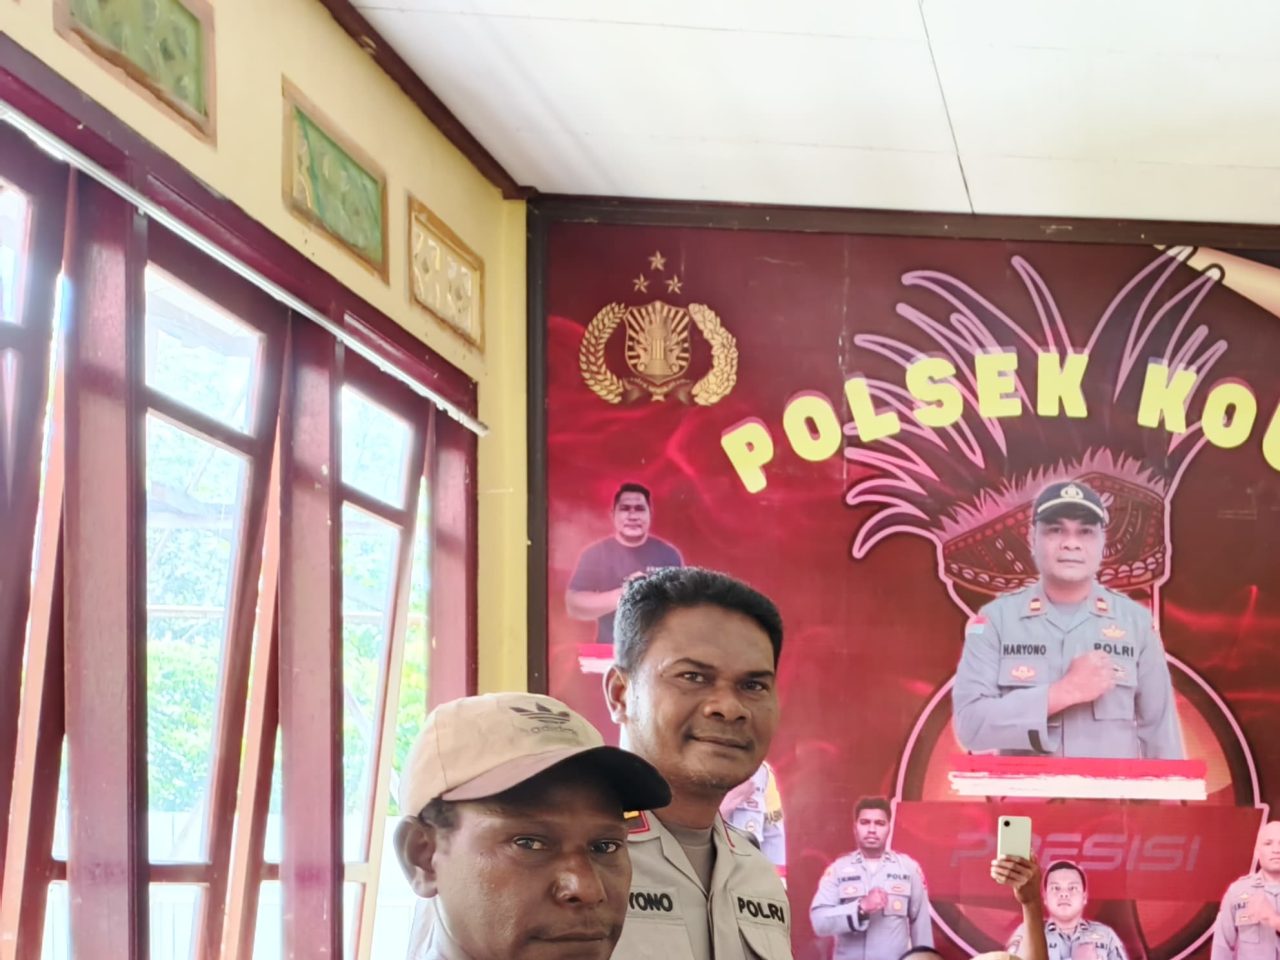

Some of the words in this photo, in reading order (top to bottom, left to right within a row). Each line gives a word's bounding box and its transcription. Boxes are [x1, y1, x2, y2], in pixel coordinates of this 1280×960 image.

[719, 349, 1089, 494] POLSEK
[1003, 644, 1047, 656] HARYONO
[1093, 642, 1135, 658] POLRI
[949, 832, 1201, 871] PESISI
[628, 892, 673, 912] YONO
[737, 896, 785, 924] POLRI
